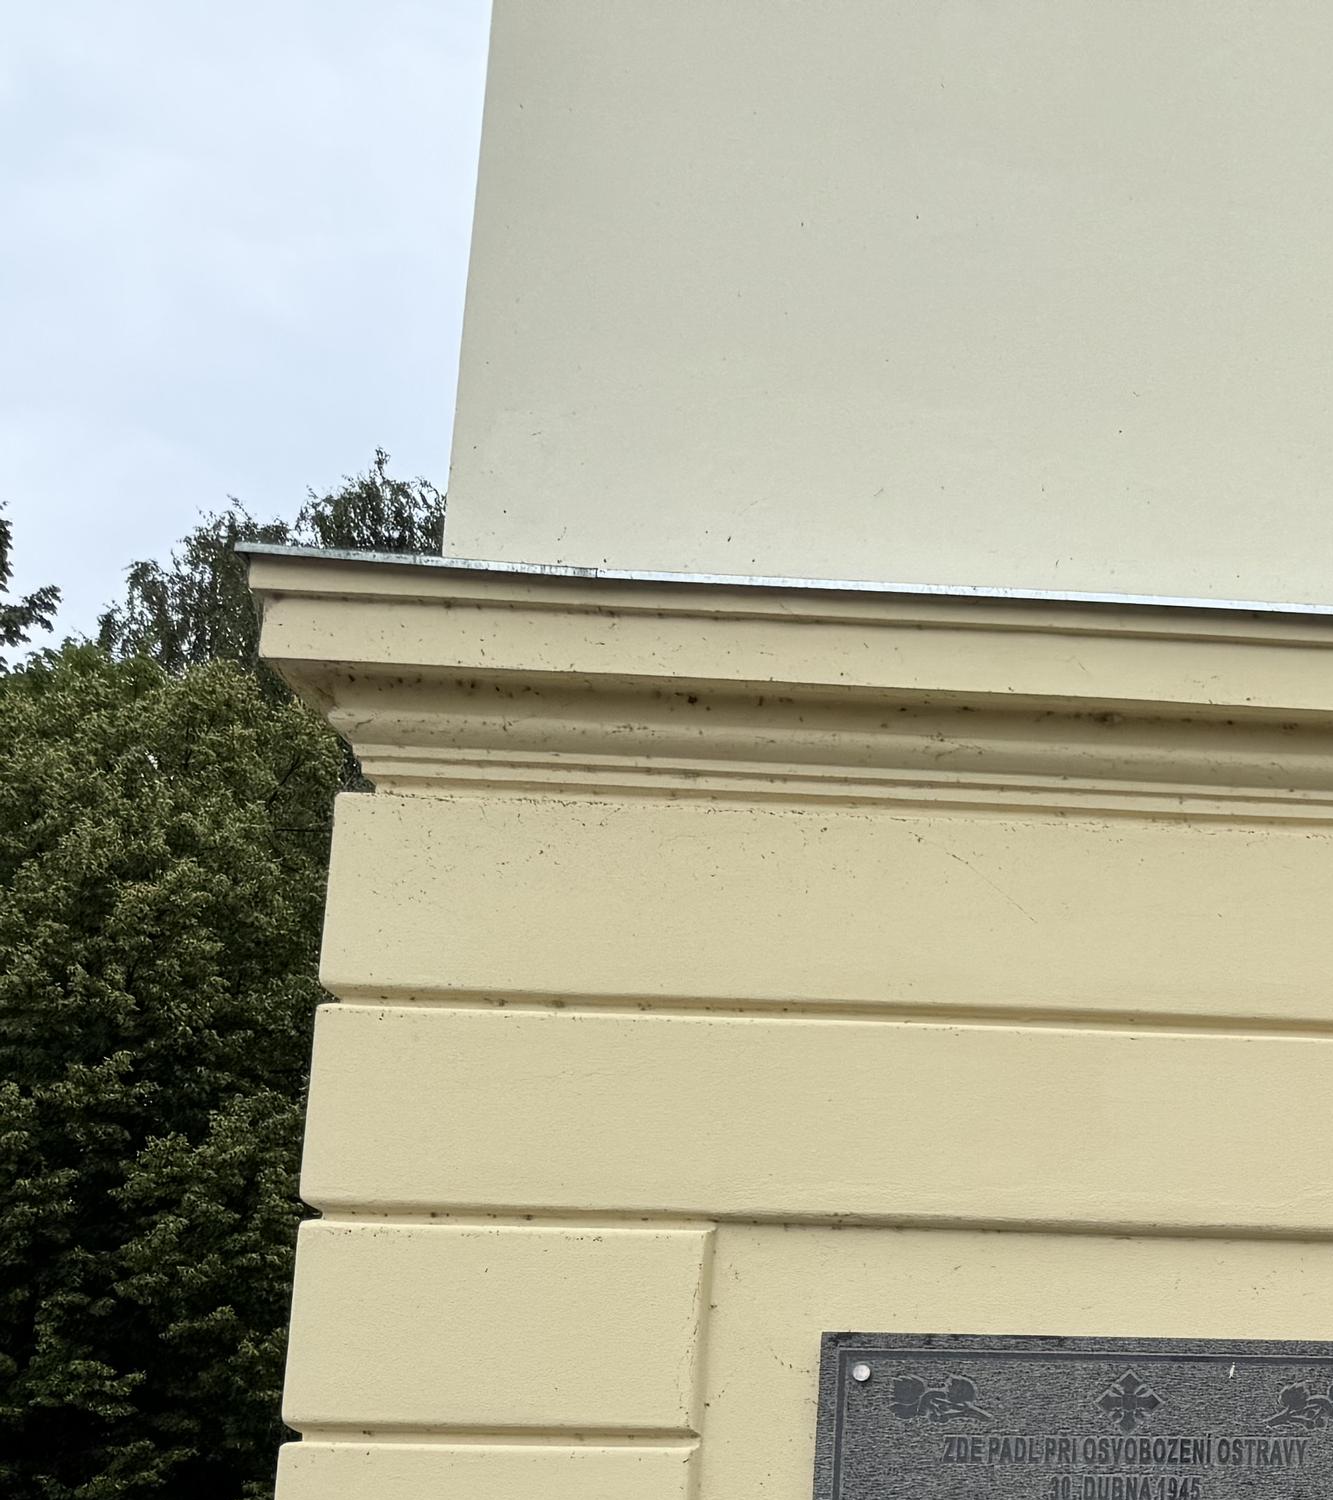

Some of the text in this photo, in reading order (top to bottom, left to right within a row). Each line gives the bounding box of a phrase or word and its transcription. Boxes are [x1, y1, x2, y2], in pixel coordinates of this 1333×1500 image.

[943, 1437, 984, 1464] ZDE
[988, 1437, 1041, 1464] PADL
[1083, 1434, 1212, 1466] OSVOBOZENÍ
[1217, 1438, 1308, 1466] OSTRAVY
